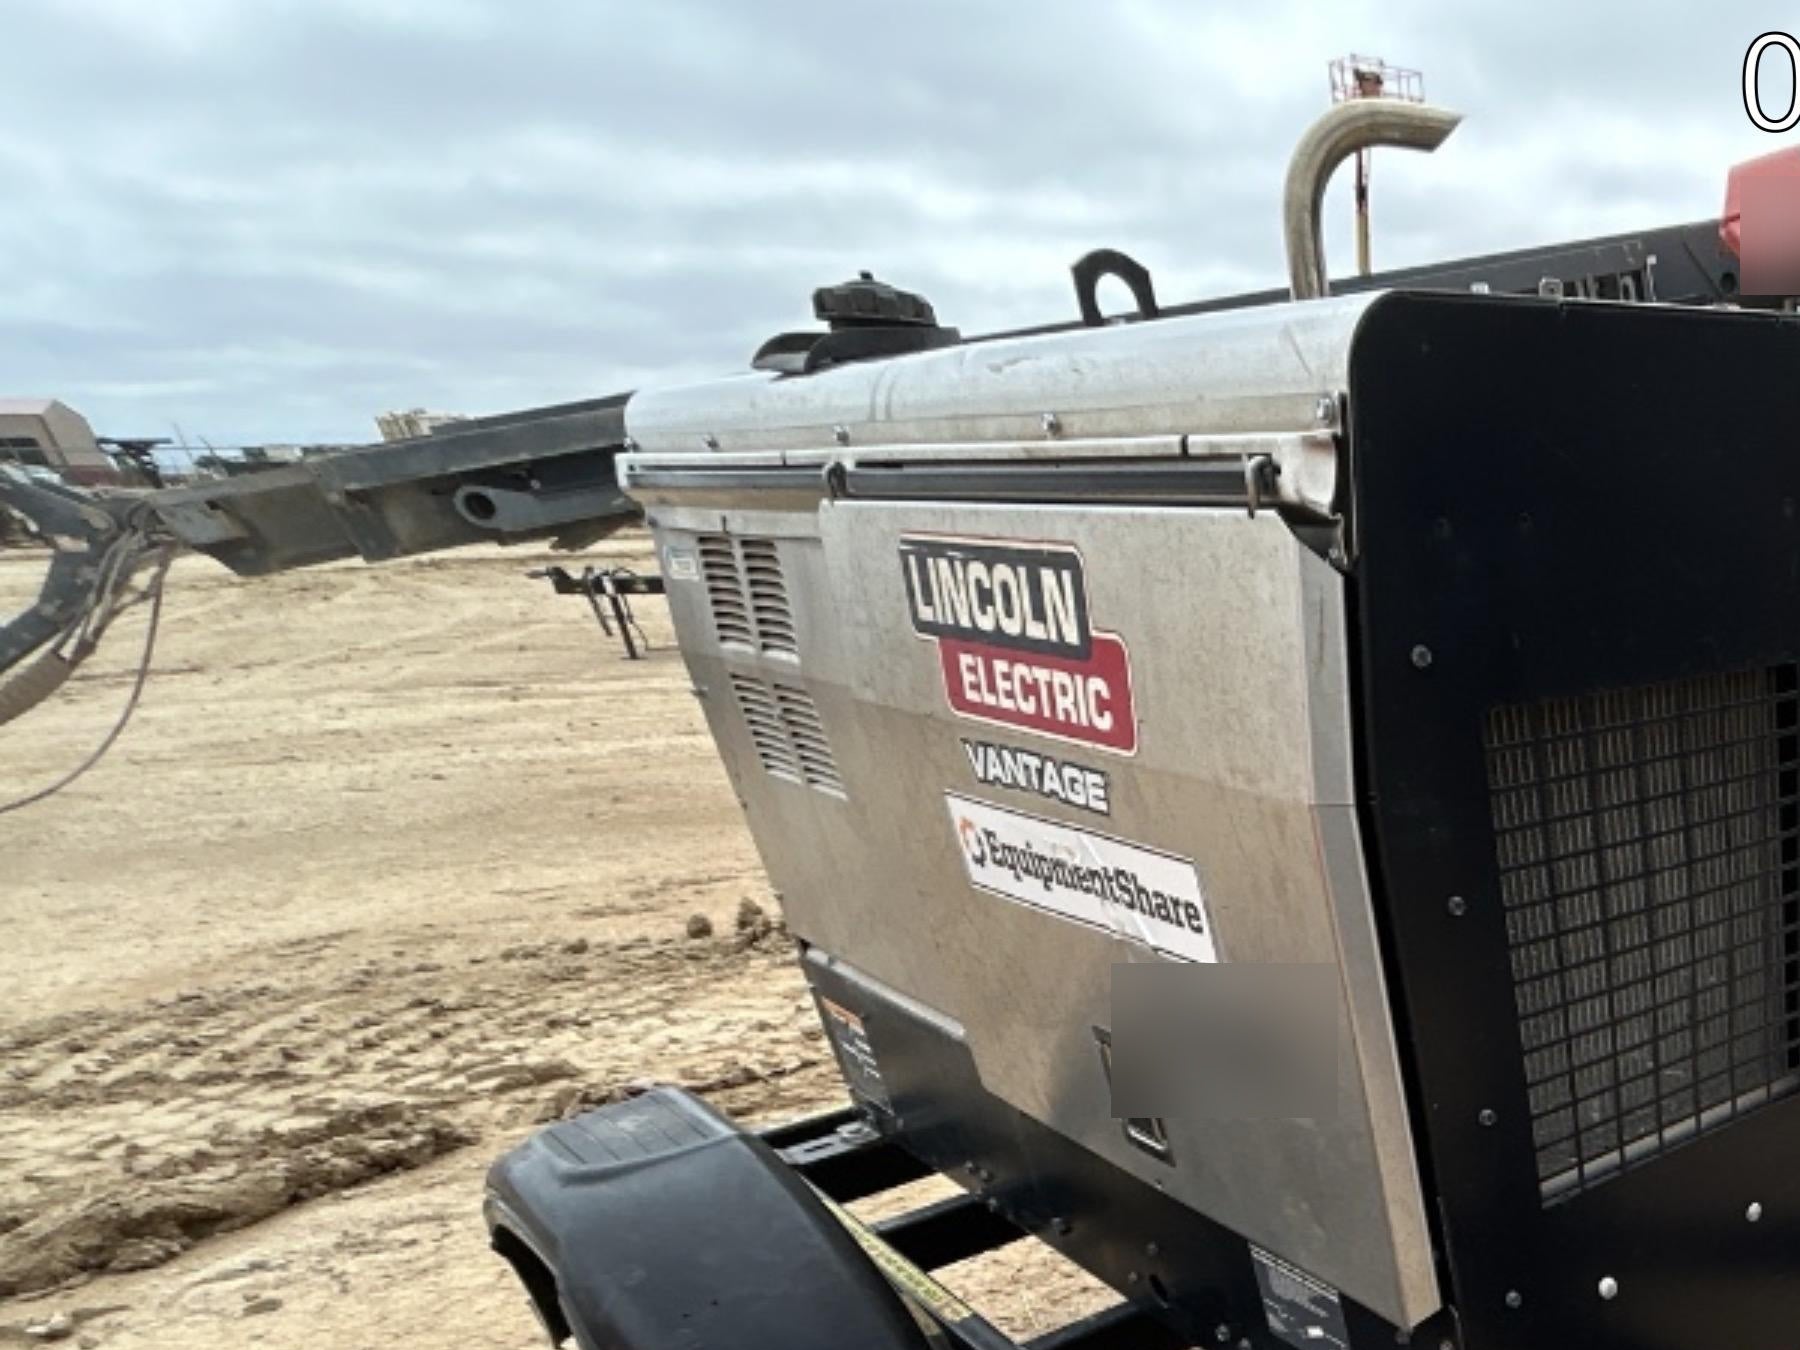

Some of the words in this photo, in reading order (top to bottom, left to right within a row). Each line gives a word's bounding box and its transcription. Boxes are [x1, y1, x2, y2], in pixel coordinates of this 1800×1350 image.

[907, 554, 1080, 646] LINCOLN
[959, 652, 1114, 732] ELECTRIC
[963, 740, 1110, 814] VANTAGE
[984, 828, 1204, 935] EquipmentShare
